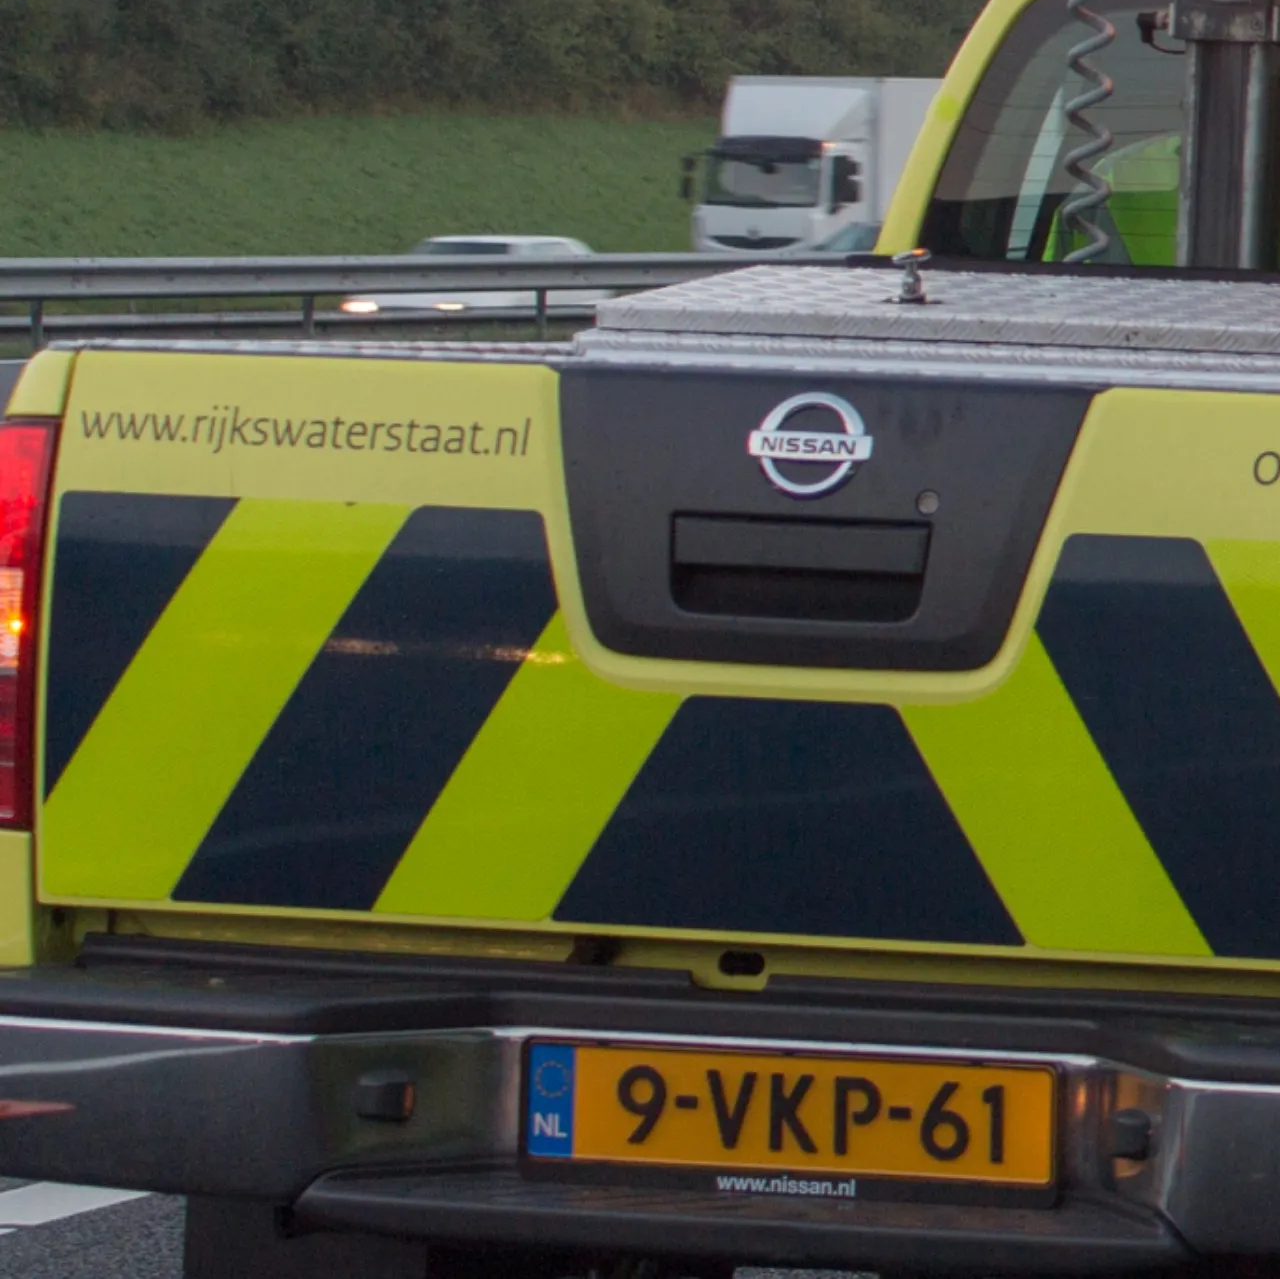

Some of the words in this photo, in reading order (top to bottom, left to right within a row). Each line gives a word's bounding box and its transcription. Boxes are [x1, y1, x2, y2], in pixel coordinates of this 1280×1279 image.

[80, 405, 532, 457] www.rijkswaterstaat.nl
[760, 435, 857, 456] NISSAN
[533, 1111, 568, 1139] NL
[615, 1064, 1007, 1166] 9-VKP-61
[716, 1174, 857, 1198] www.nissan.nl
